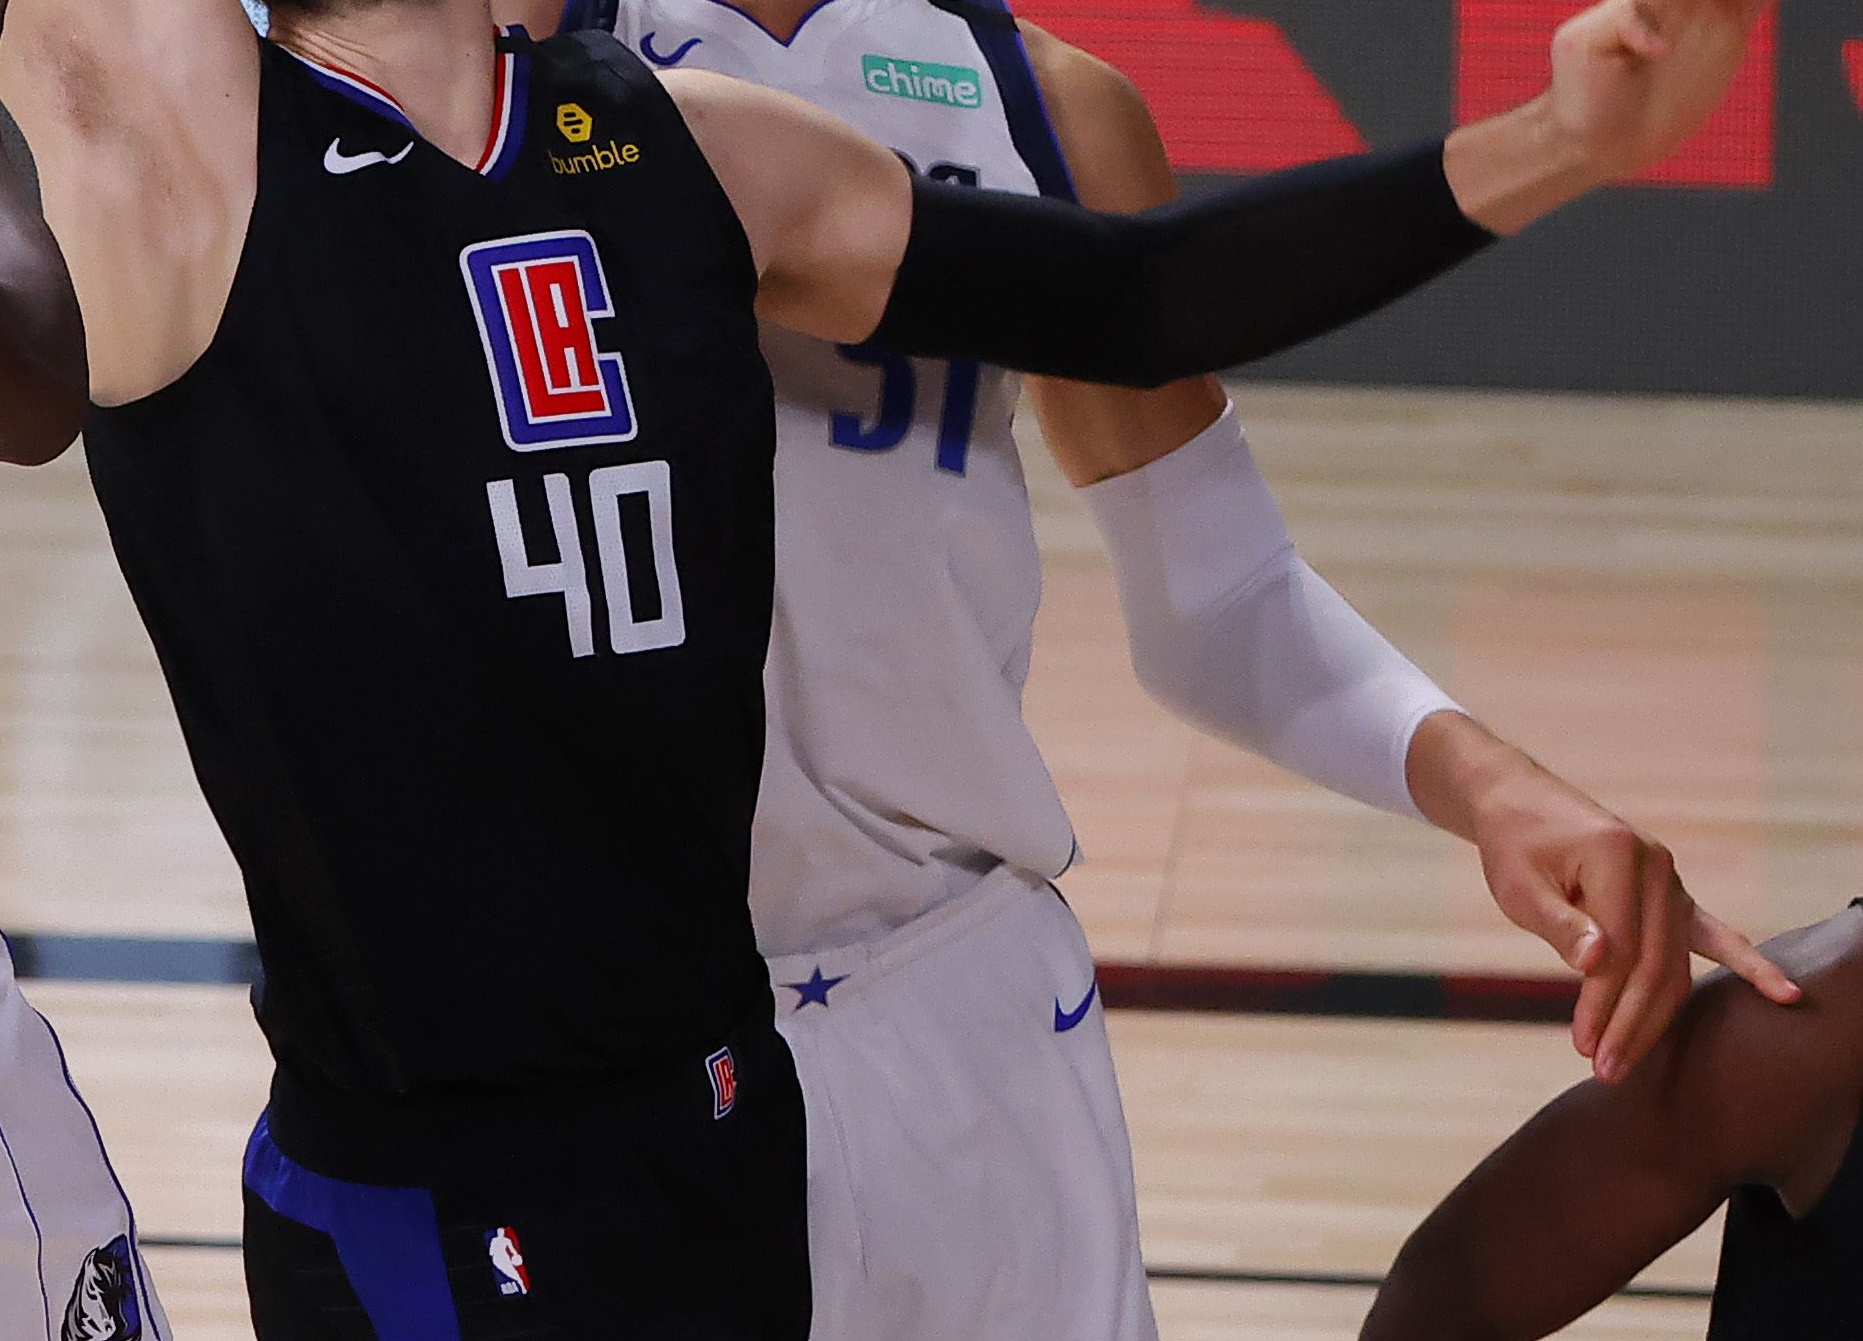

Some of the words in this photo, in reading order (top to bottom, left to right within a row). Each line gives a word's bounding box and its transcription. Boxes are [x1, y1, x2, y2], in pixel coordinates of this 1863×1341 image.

[867, 61, 979, 105] chime
[547, 140, 640, 174] bumble
[486, 460, 687, 659] 40
